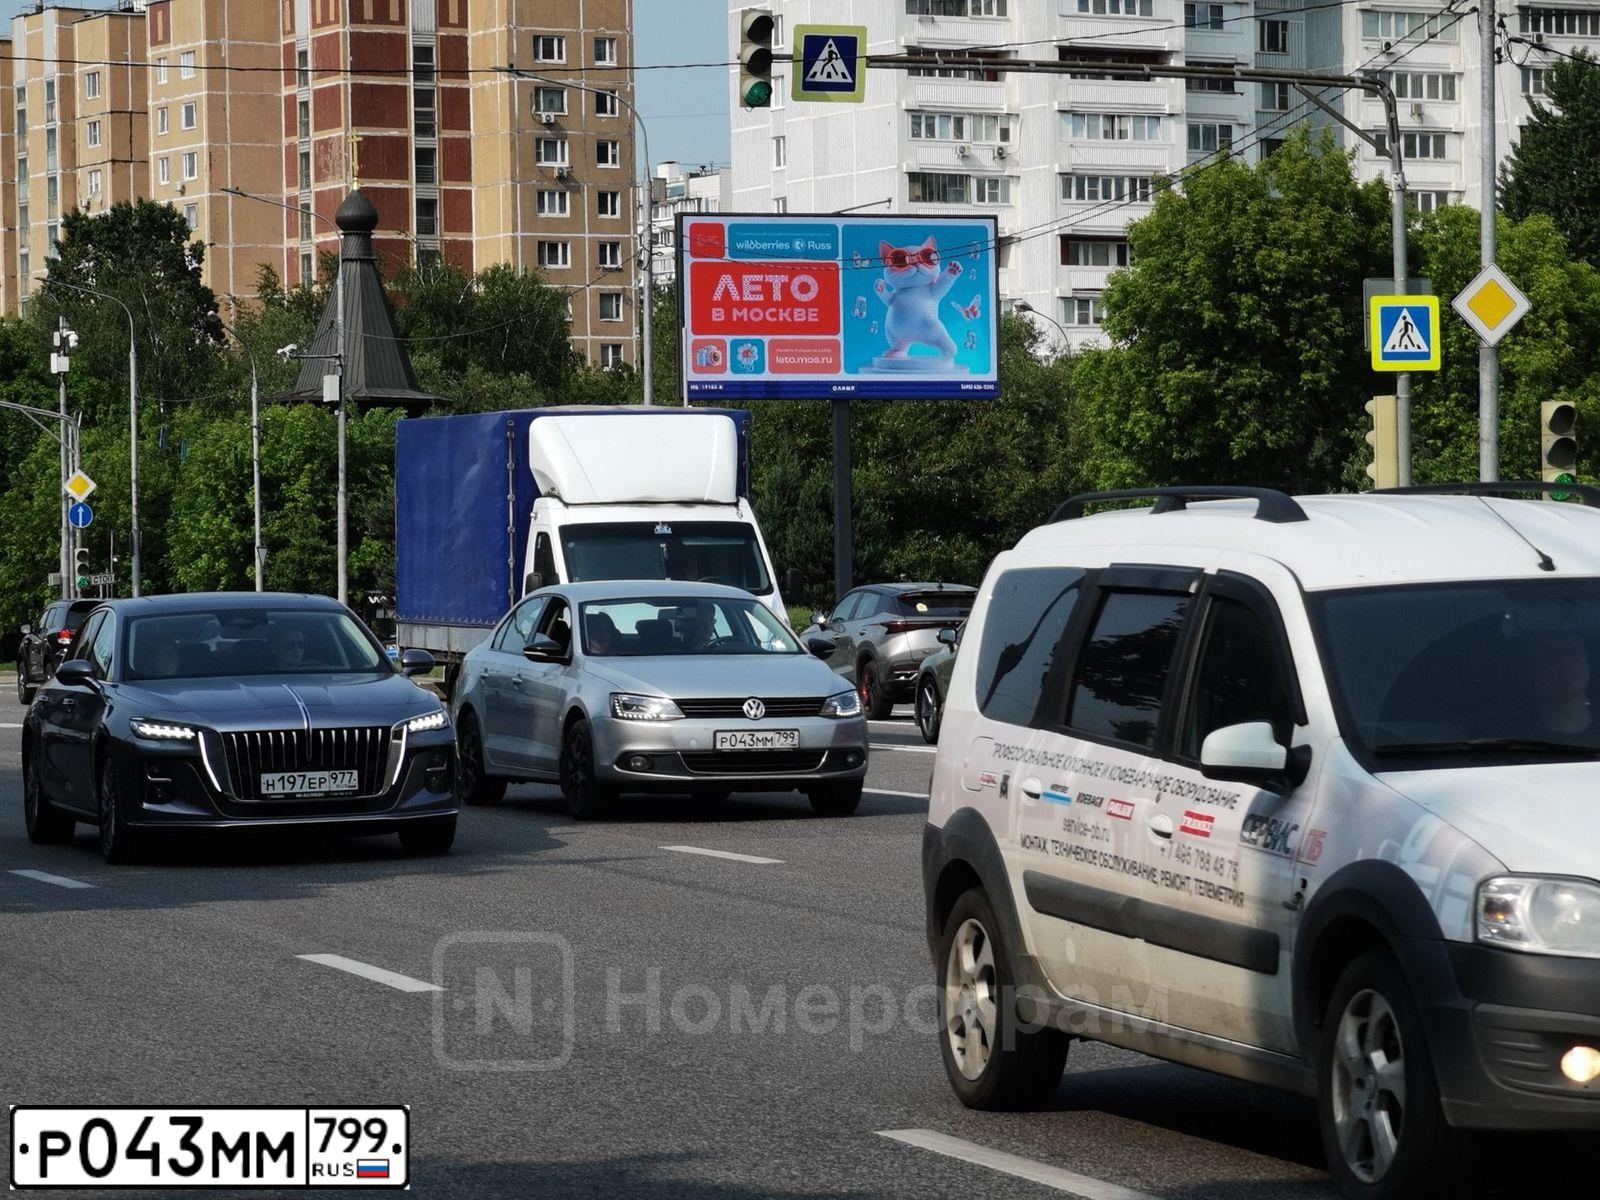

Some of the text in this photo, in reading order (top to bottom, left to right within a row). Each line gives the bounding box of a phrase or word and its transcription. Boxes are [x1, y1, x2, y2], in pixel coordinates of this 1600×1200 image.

[736, 240, 832, 250] wildberries Russ
[711, 274, 819, 302] ЛЕТО
[711, 308, 820, 322] В МОСКВЕ
[775, 355, 833, 364] leto.mos.ru
[775, 731, 796, 743] 799
[330, 771, 354, 784] 977
